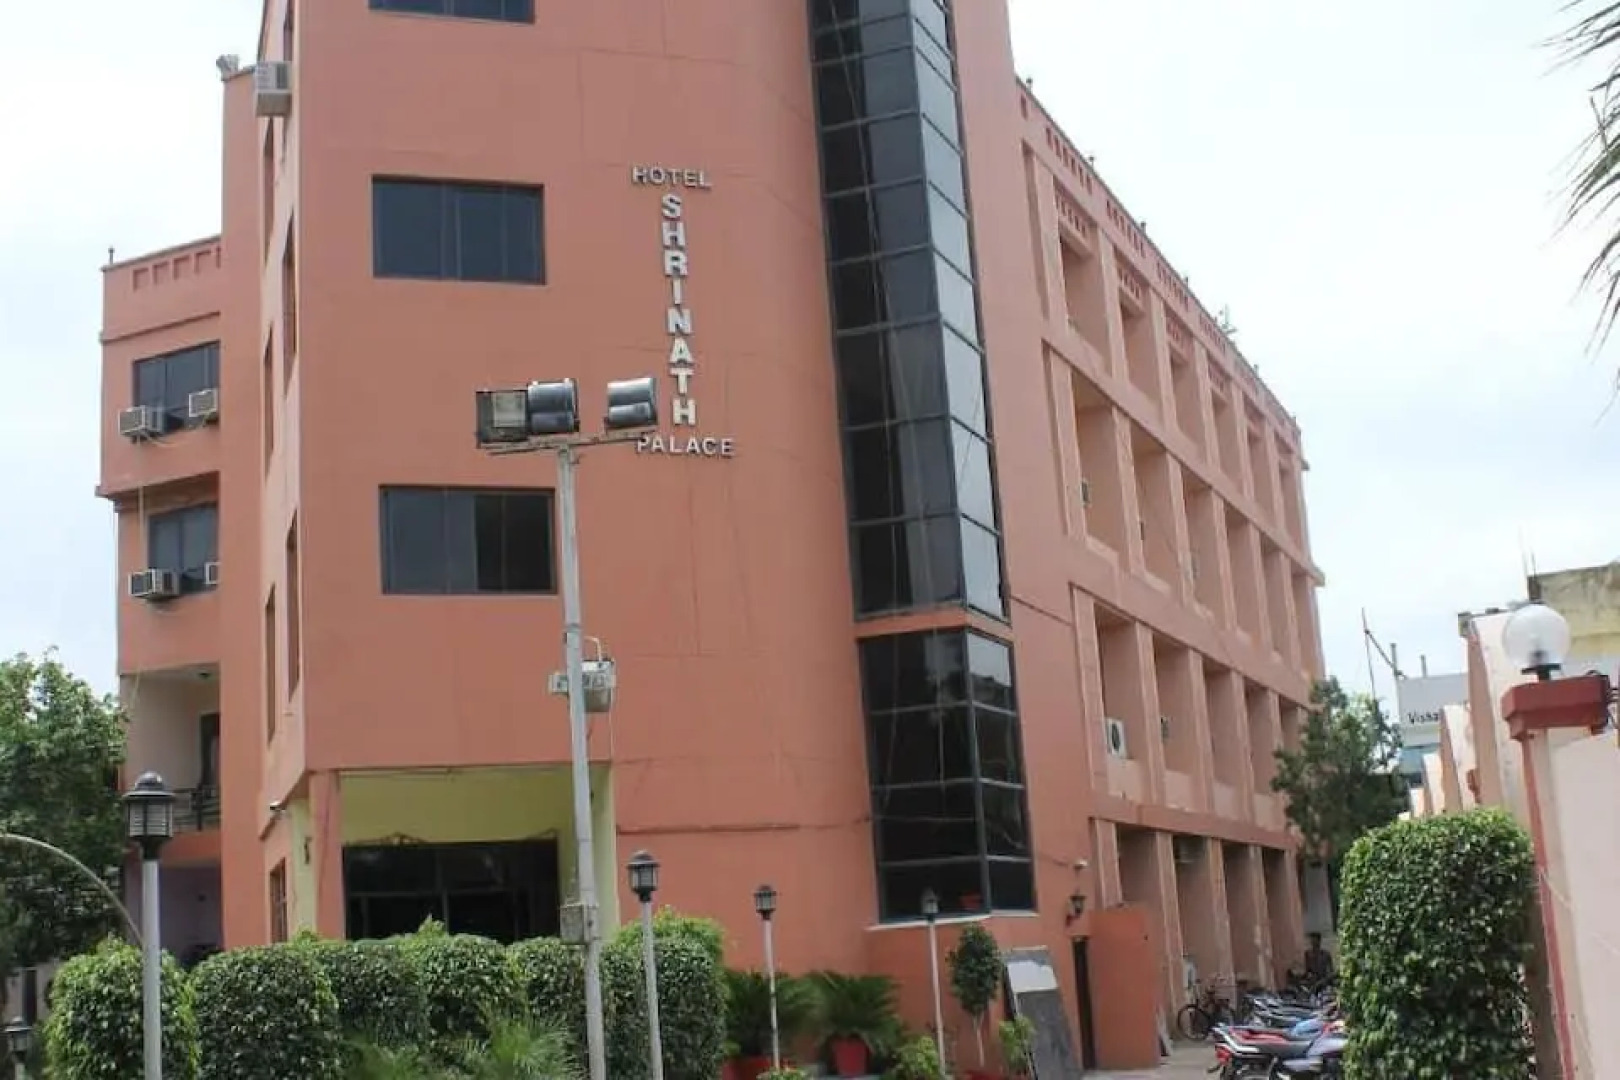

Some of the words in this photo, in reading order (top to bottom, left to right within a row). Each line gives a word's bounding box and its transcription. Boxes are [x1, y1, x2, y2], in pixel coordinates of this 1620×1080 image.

[631, 165, 712, 189] HOTEL
[661, 193, 696, 426] SHRINATH
[635, 434, 735, 458] PALACE
